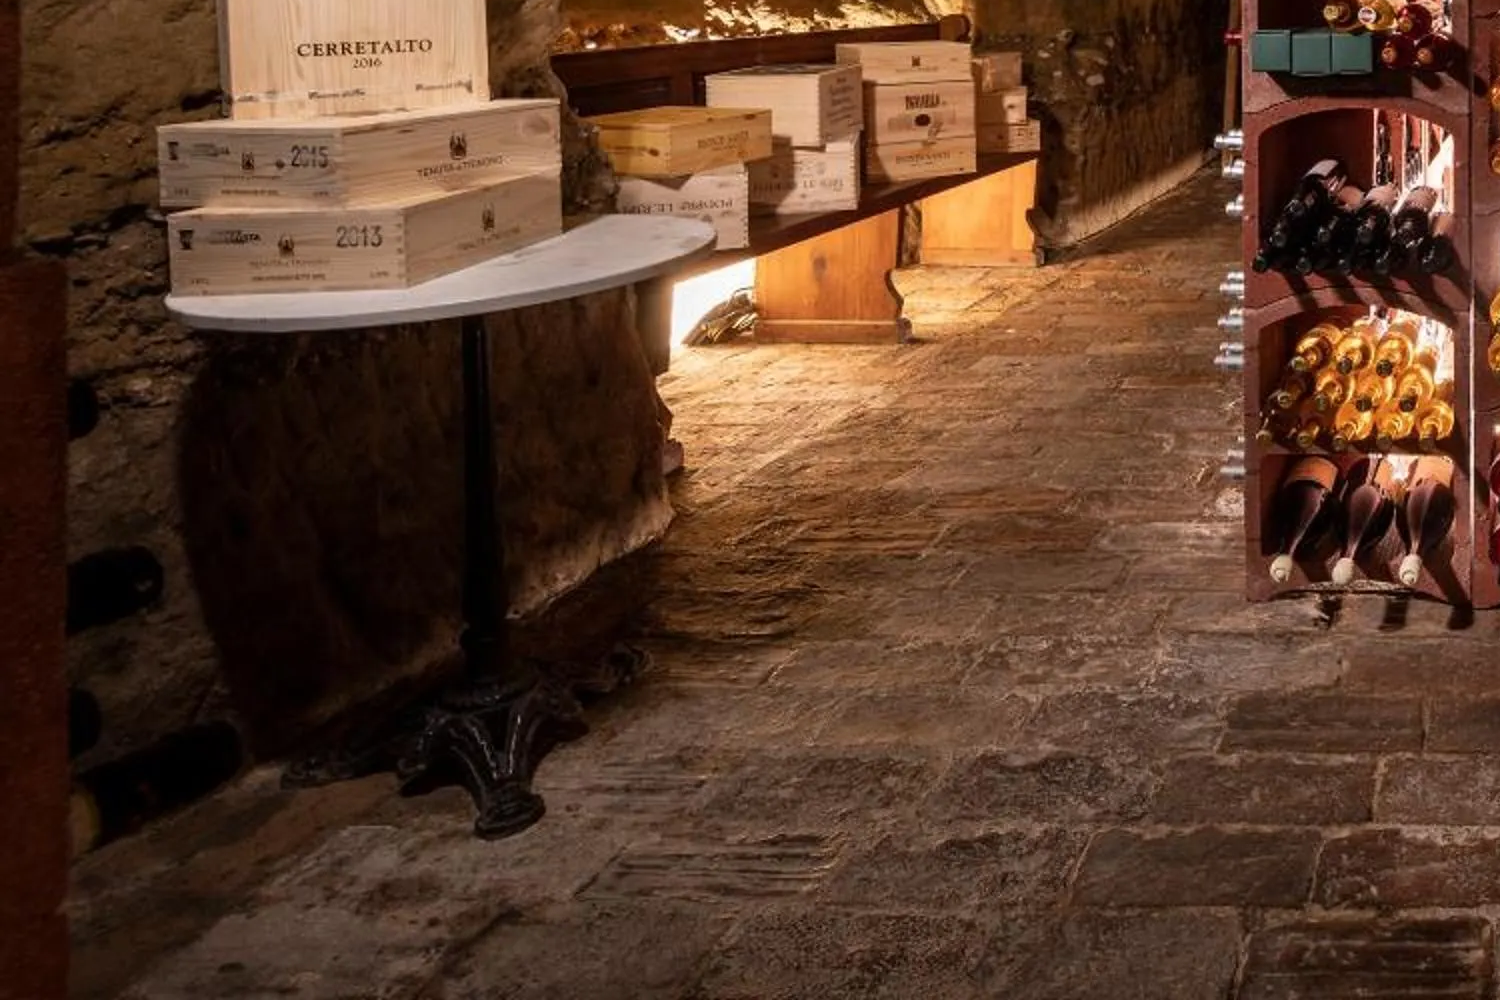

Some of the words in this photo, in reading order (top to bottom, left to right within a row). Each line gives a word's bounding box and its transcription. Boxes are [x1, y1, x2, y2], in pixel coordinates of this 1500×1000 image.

[296, 38, 433, 58] CERRETALTO
[352, 57, 383, 69] 2016
[291, 145, 329, 168] 2015
[336, 225, 383, 248] 2013
